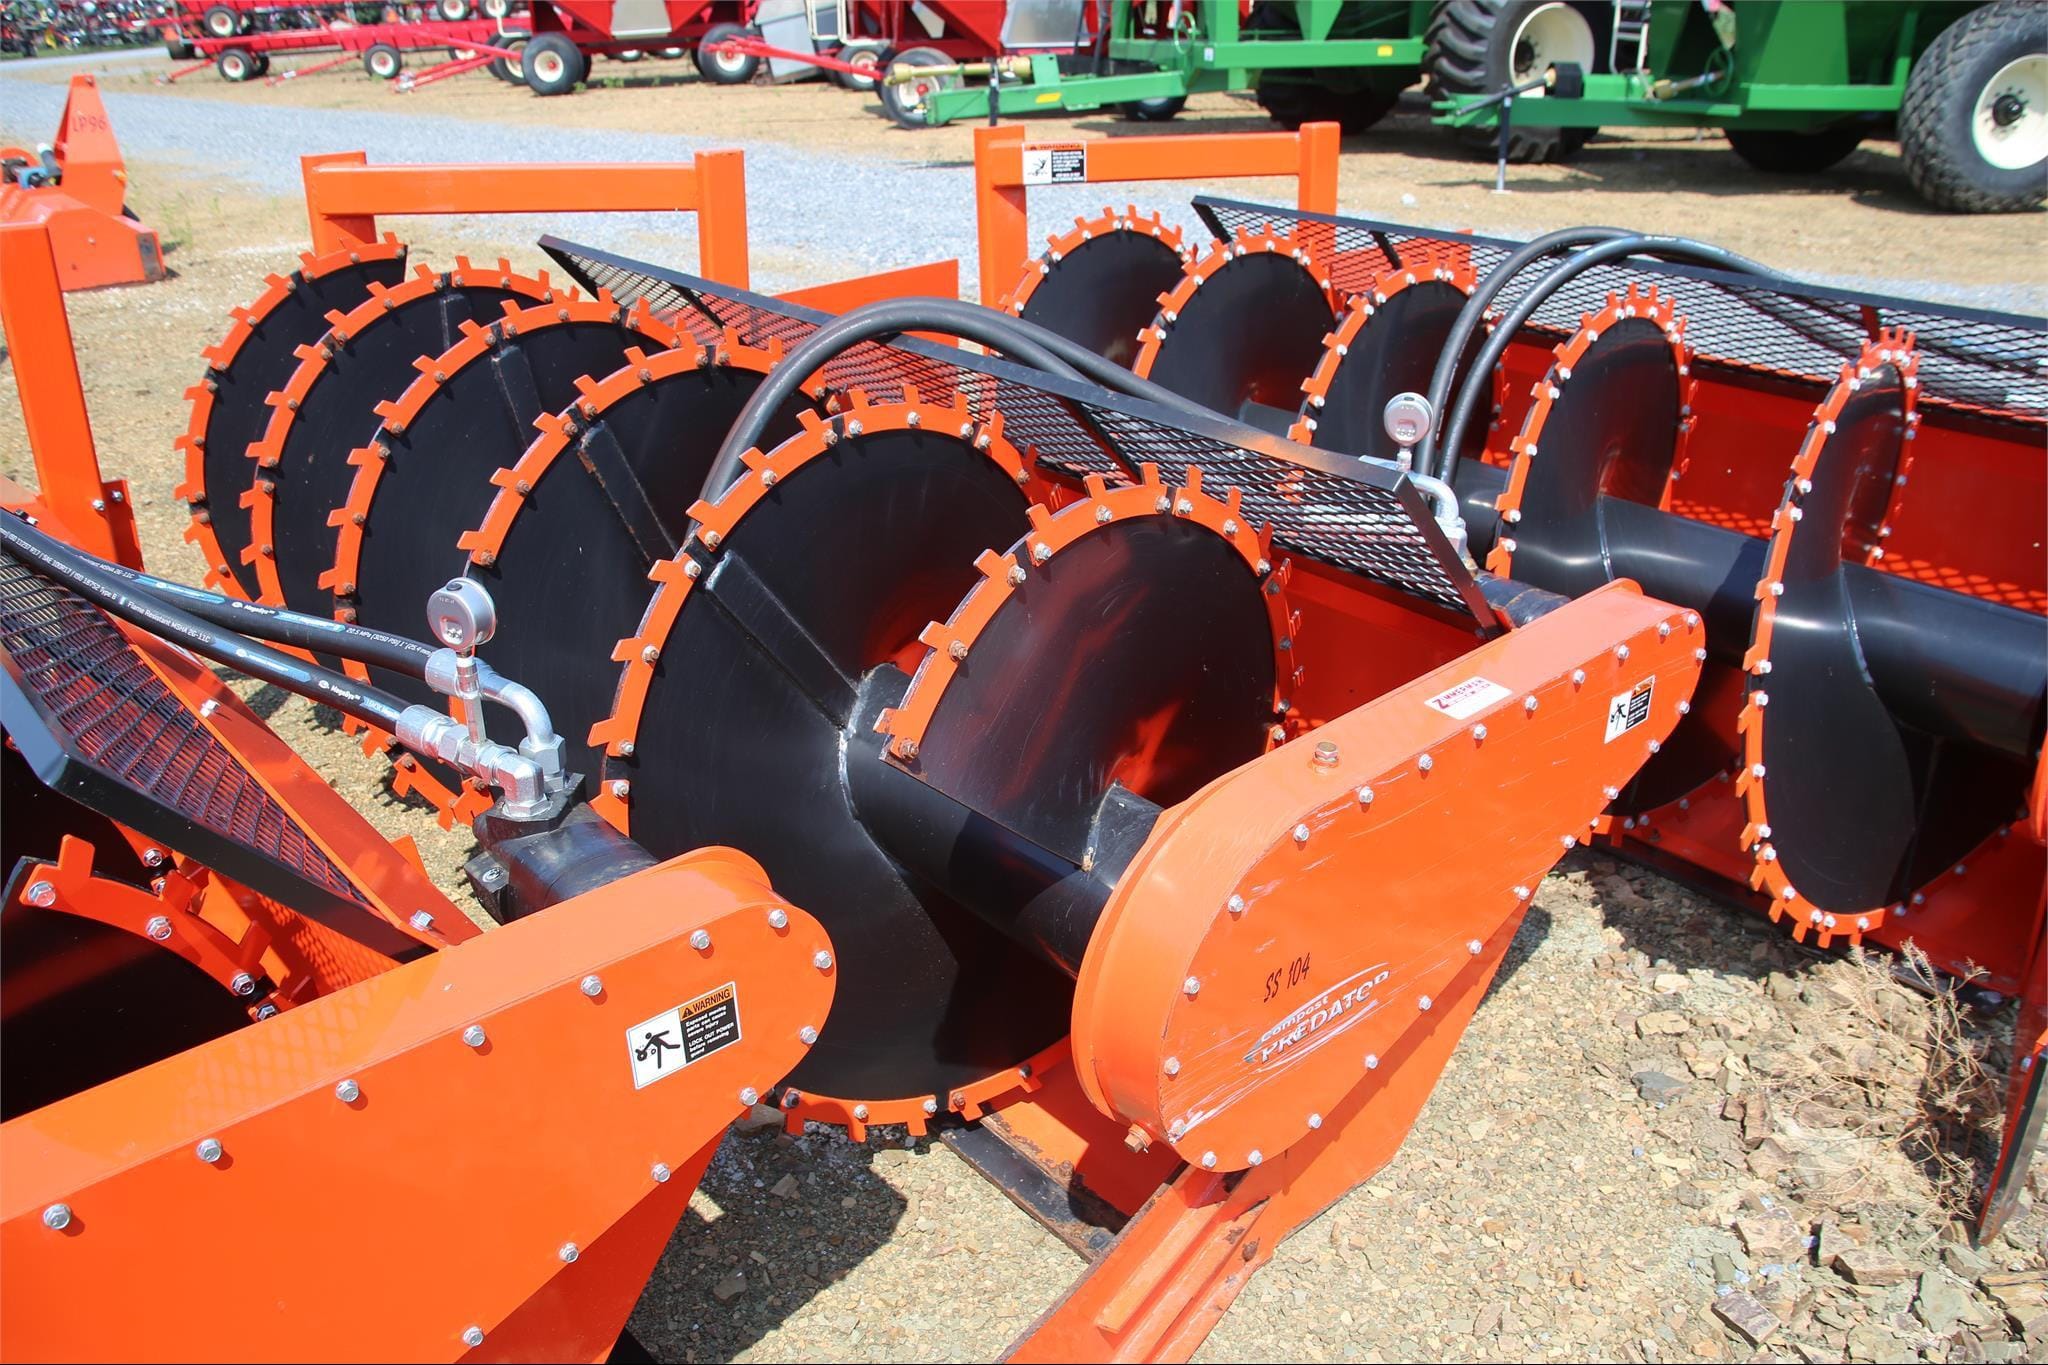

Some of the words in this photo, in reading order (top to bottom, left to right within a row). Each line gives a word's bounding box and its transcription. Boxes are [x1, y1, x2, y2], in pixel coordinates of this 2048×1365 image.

[127, 601, 146, 615] Flame
[144, 609, 172, 627] Resistant
[170, 621, 188, 634] MSHA
[187, 629, 211, 643] 2G-11C
[1263, 968, 1282, 1003] SS
[1286, 952, 1311, 989] 104
[692, 988, 731, 1013] WARNING
[689, 1037, 704, 1048] LOCK
[704, 1030, 715, 1040] OUT
[715, 1022, 735, 1034] POWER
[689, 1041, 706, 1053] before
[707, 1031, 730, 1044] removing
